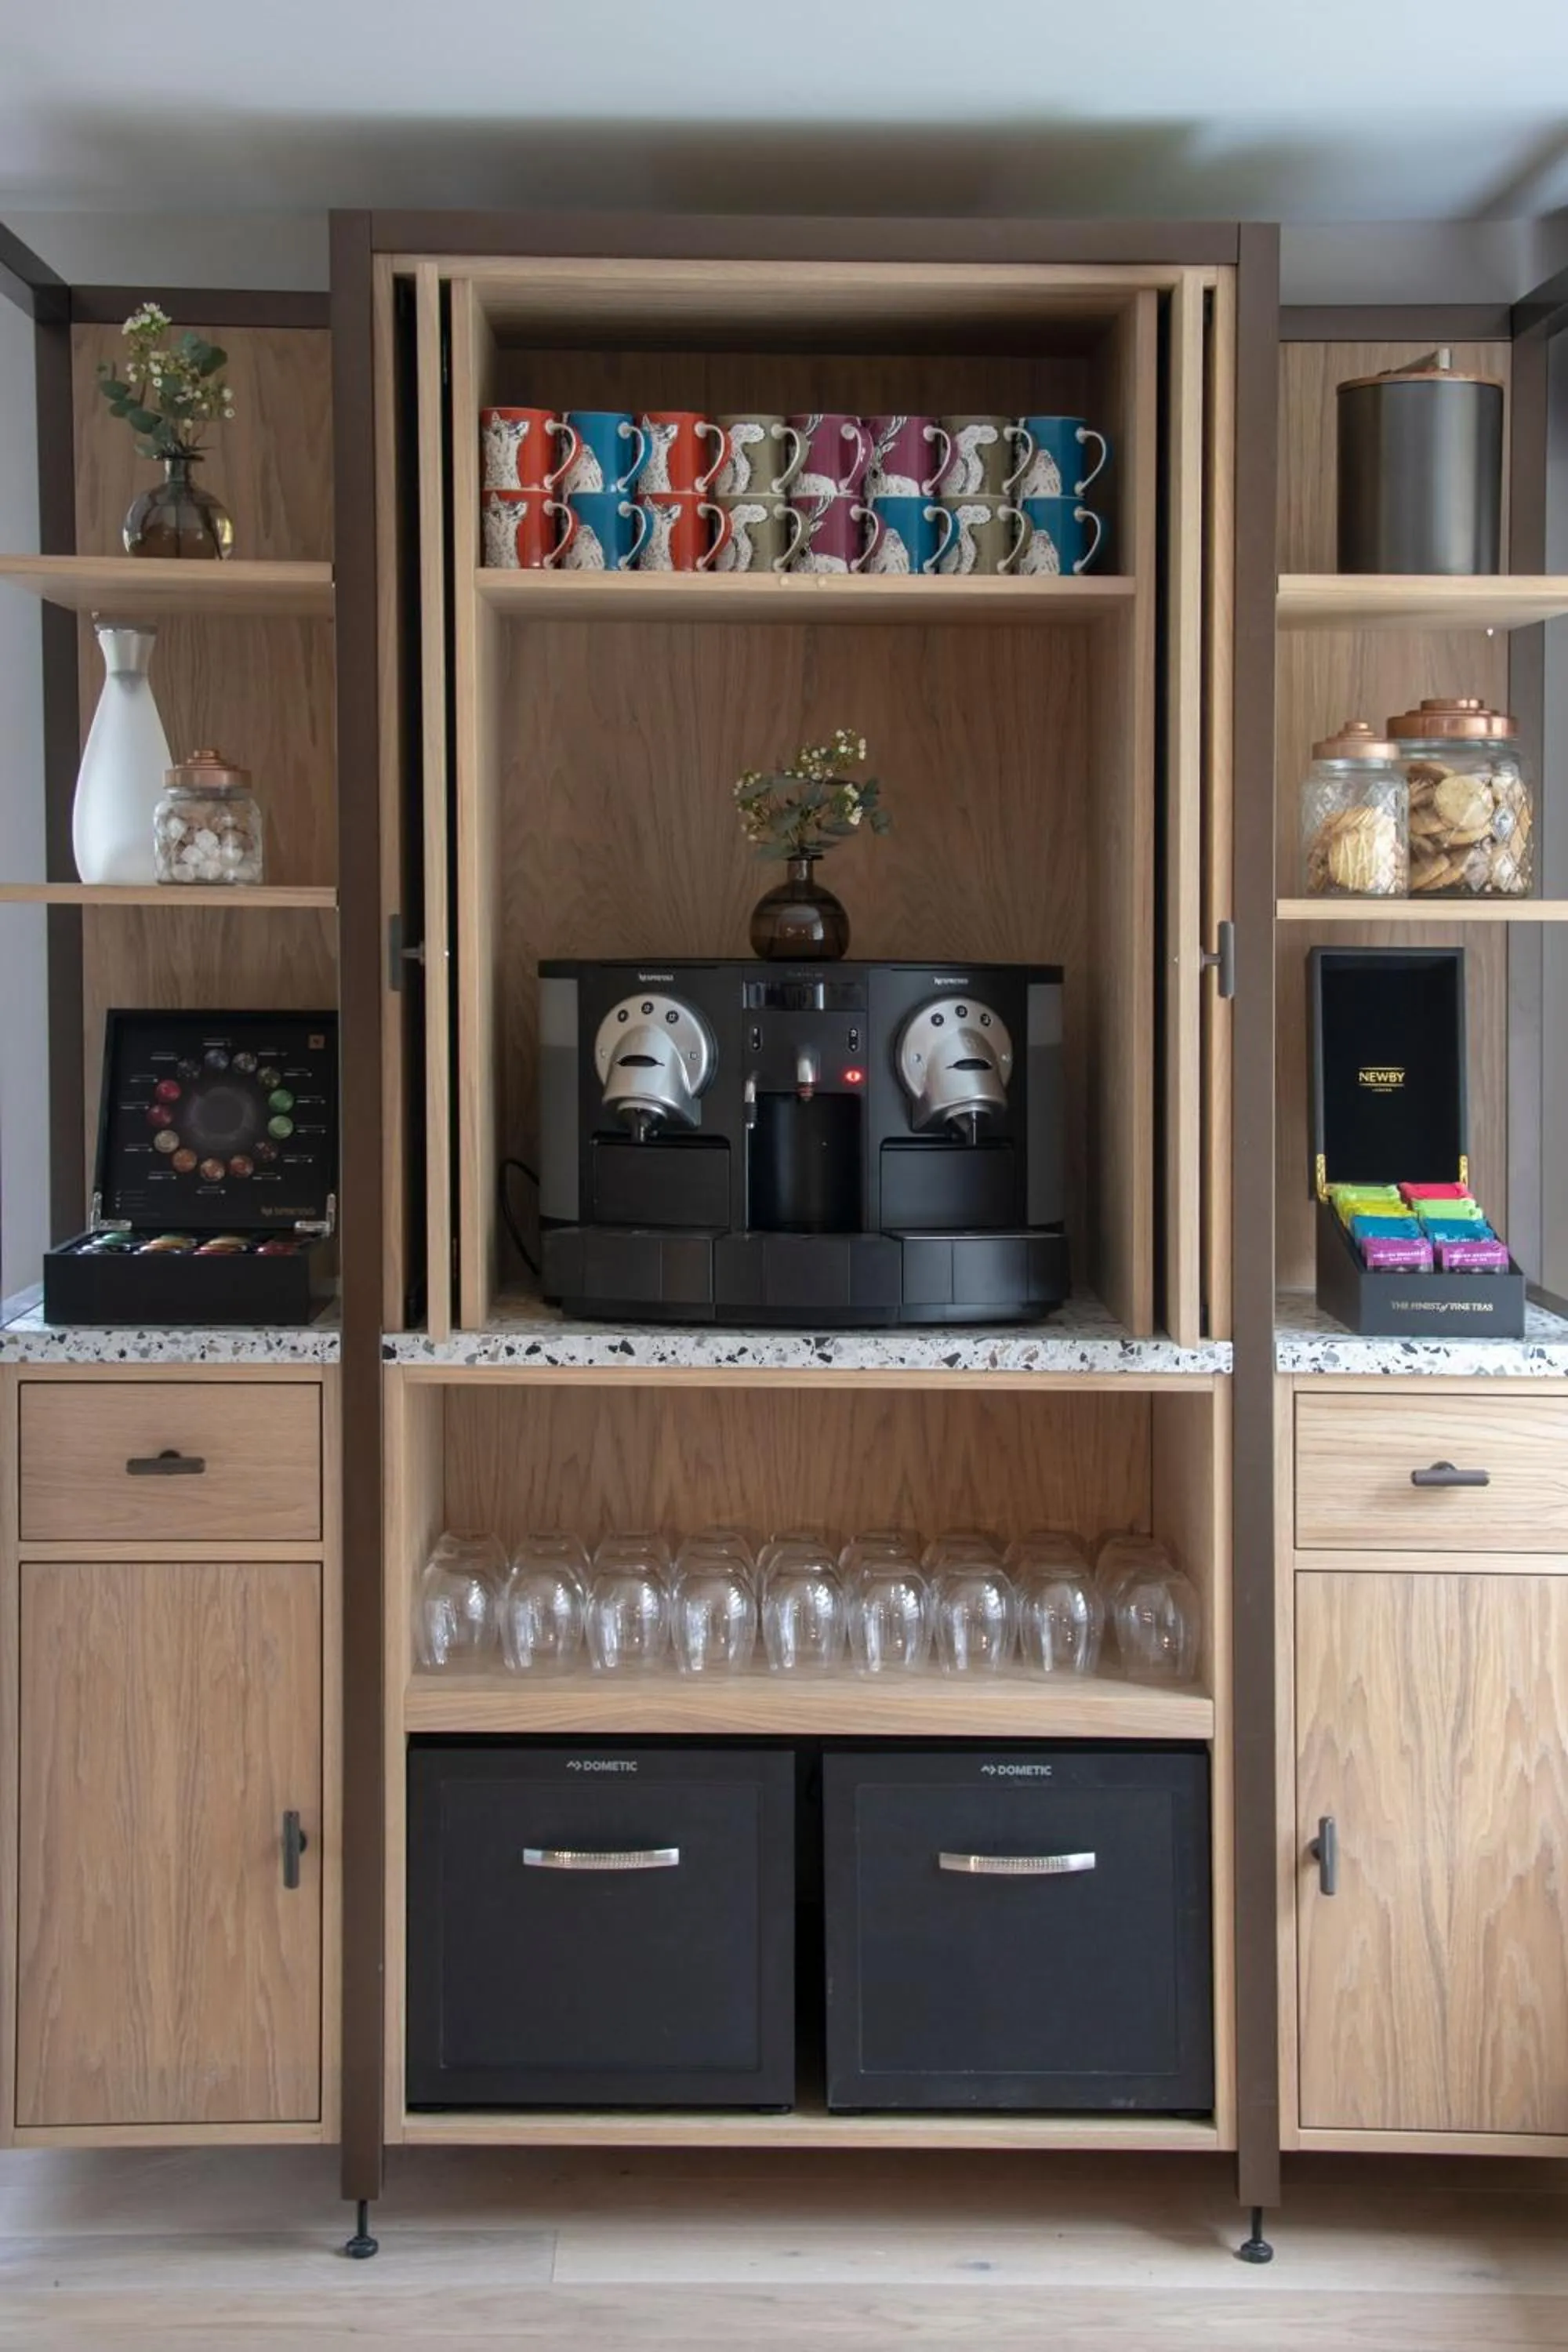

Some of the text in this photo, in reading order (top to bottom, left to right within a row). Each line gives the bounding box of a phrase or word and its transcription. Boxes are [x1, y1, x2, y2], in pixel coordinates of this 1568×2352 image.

[1359, 1071, 1405, 1083] NEWBY
[1472, 1303, 1494, 1312] TEAS
[583, 1760, 638, 1772] DOMETIC
[997, 1765, 1052, 1776] DOMETIC
